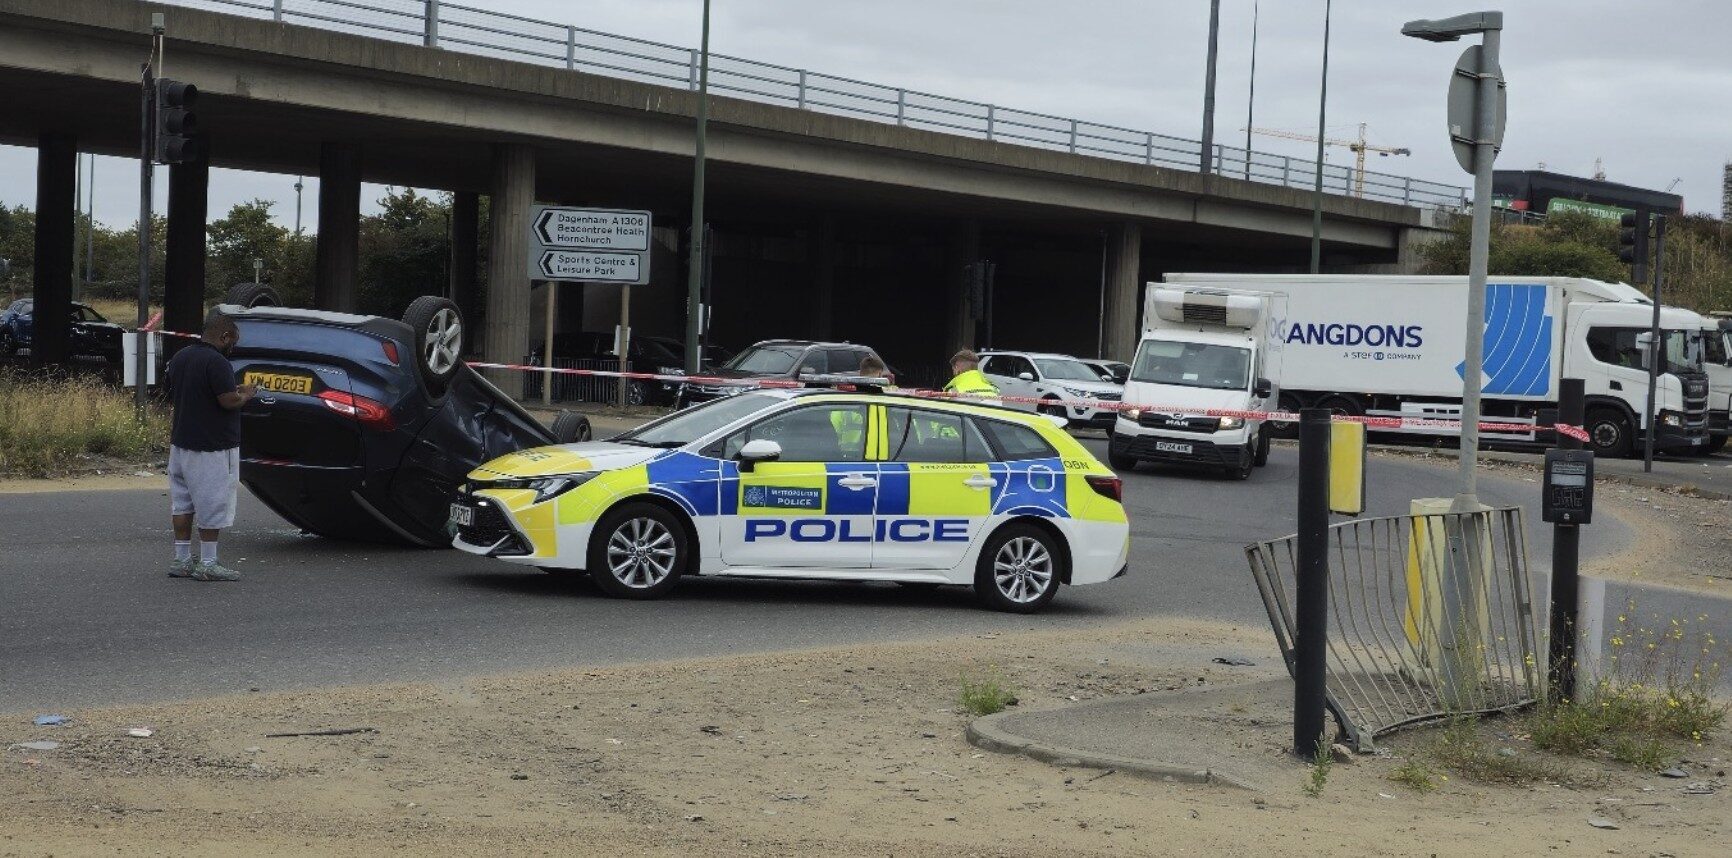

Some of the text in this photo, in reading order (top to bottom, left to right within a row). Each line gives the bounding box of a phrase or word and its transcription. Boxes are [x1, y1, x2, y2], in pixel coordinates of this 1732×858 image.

[558, 214, 608, 224] Dagenham
[557, 224, 645, 236] Beacontree Heath
[557, 234, 612, 244] Hornchurch
[558, 255, 636, 266] Sports Centre &
[557, 265, 615, 275] Leisure Park
[1284, 323, 1423, 348] ANGDONS
[1165, 419, 1189, 427] MAN
[777, 497, 812, 506] POLICE
[744, 519, 970, 543] POLICE
